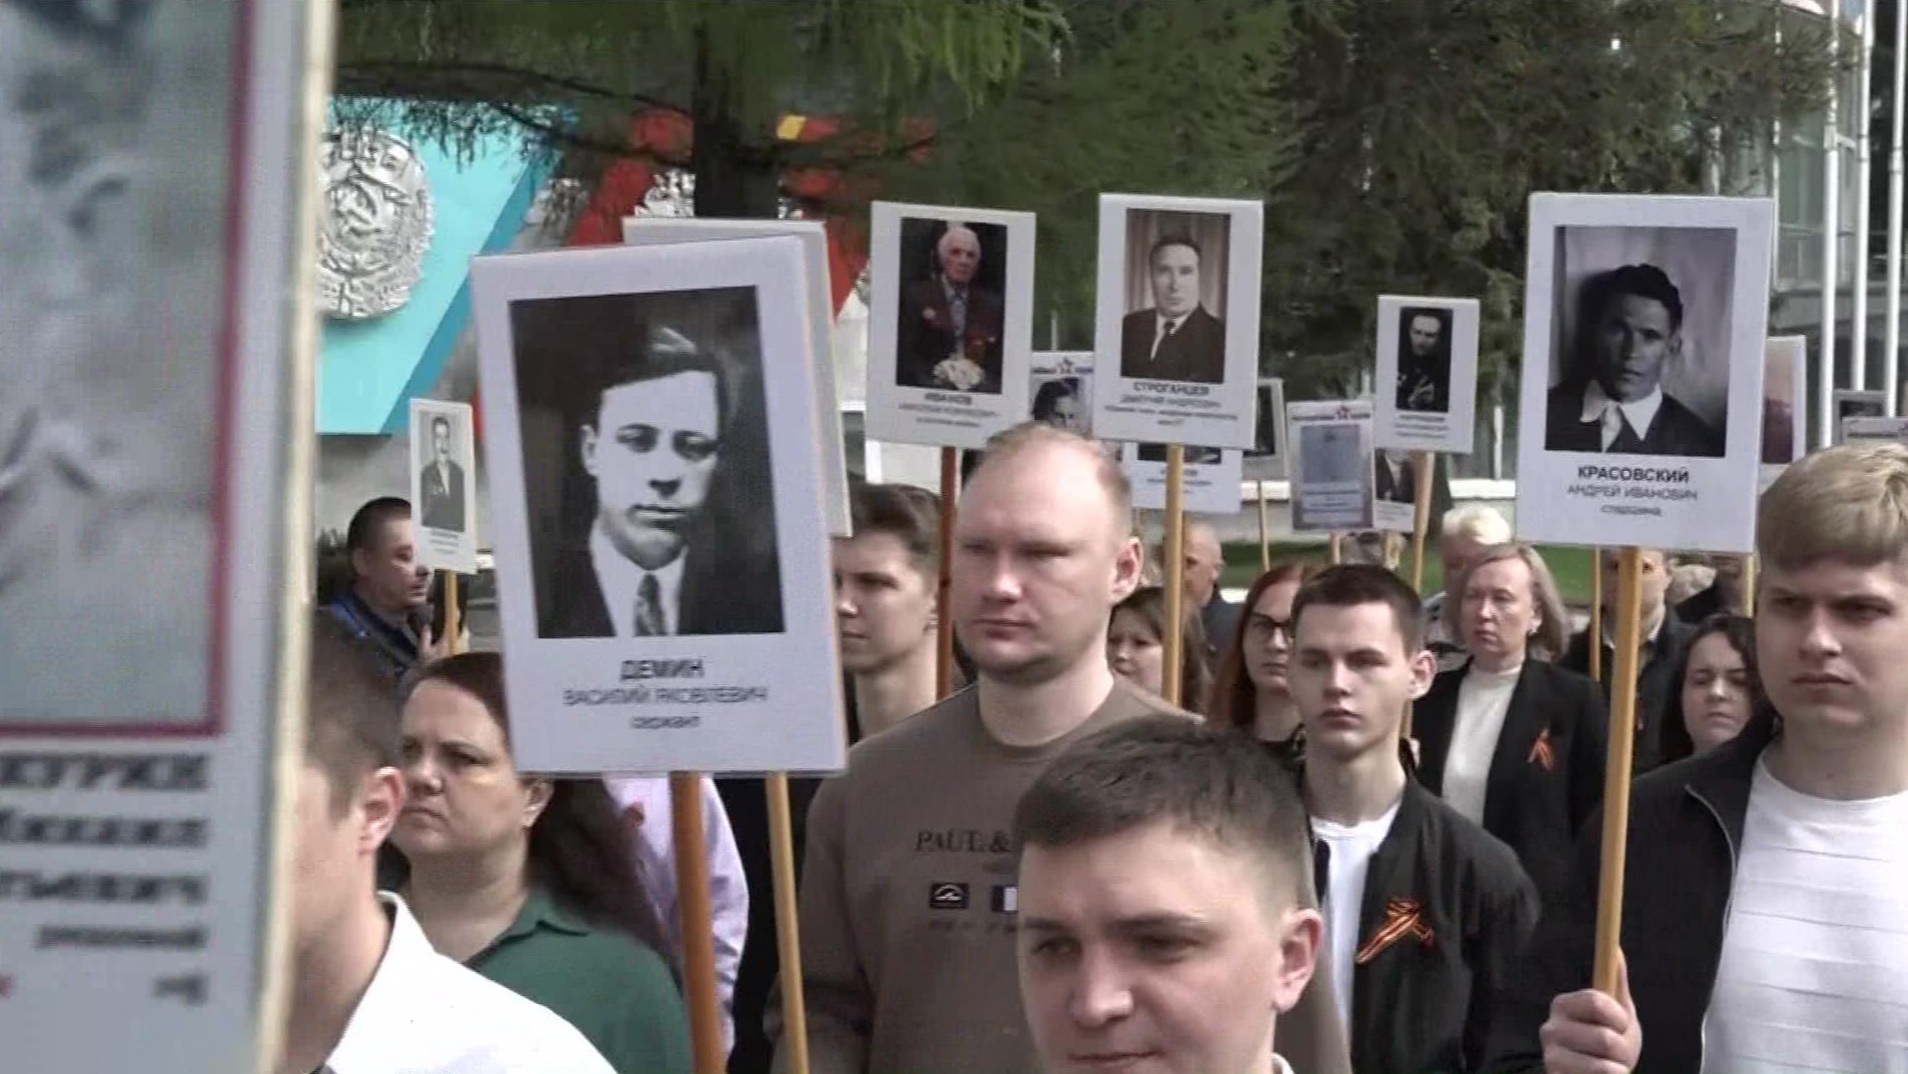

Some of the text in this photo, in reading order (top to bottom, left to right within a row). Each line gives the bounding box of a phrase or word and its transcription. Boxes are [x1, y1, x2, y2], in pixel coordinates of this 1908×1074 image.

[1577, 466, 1690, 483] КРАСОВСКИЙ
[1567, 485, 1698, 500] АНДРЕЙ ИВАНОВИЧ
[620, 659, 705, 681] ДЕМИН
